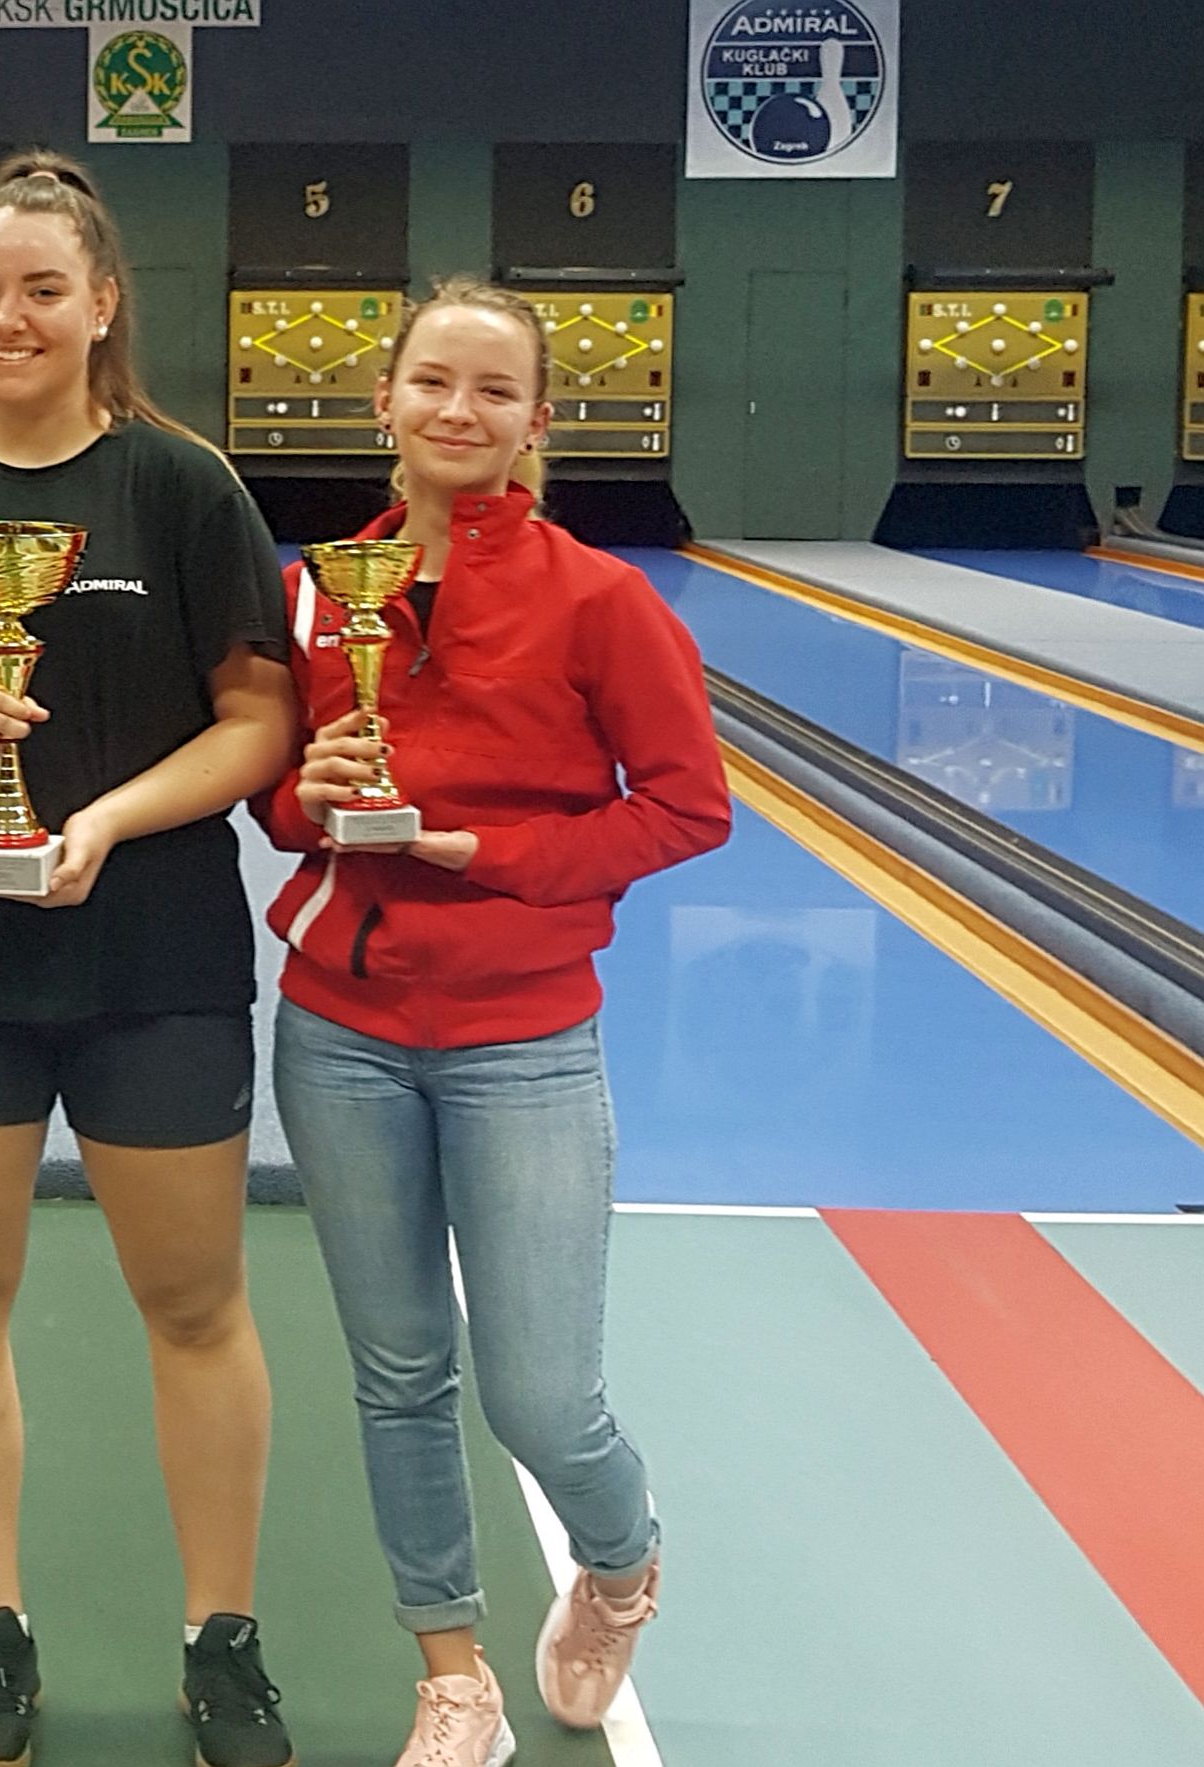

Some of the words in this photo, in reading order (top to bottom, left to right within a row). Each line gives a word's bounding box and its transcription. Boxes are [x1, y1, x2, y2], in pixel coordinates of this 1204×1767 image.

[731, 14, 859, 36] ADMIRAL
[722, 47, 809, 63] KUGLAČKI
[742, 63, 789, 76] KLUB
[305, 180, 330, 219] 5
[570, 181, 595, 218] 6
[987, 180, 1013, 217] 7
[63, 578, 149, 595] ADMIRAL
